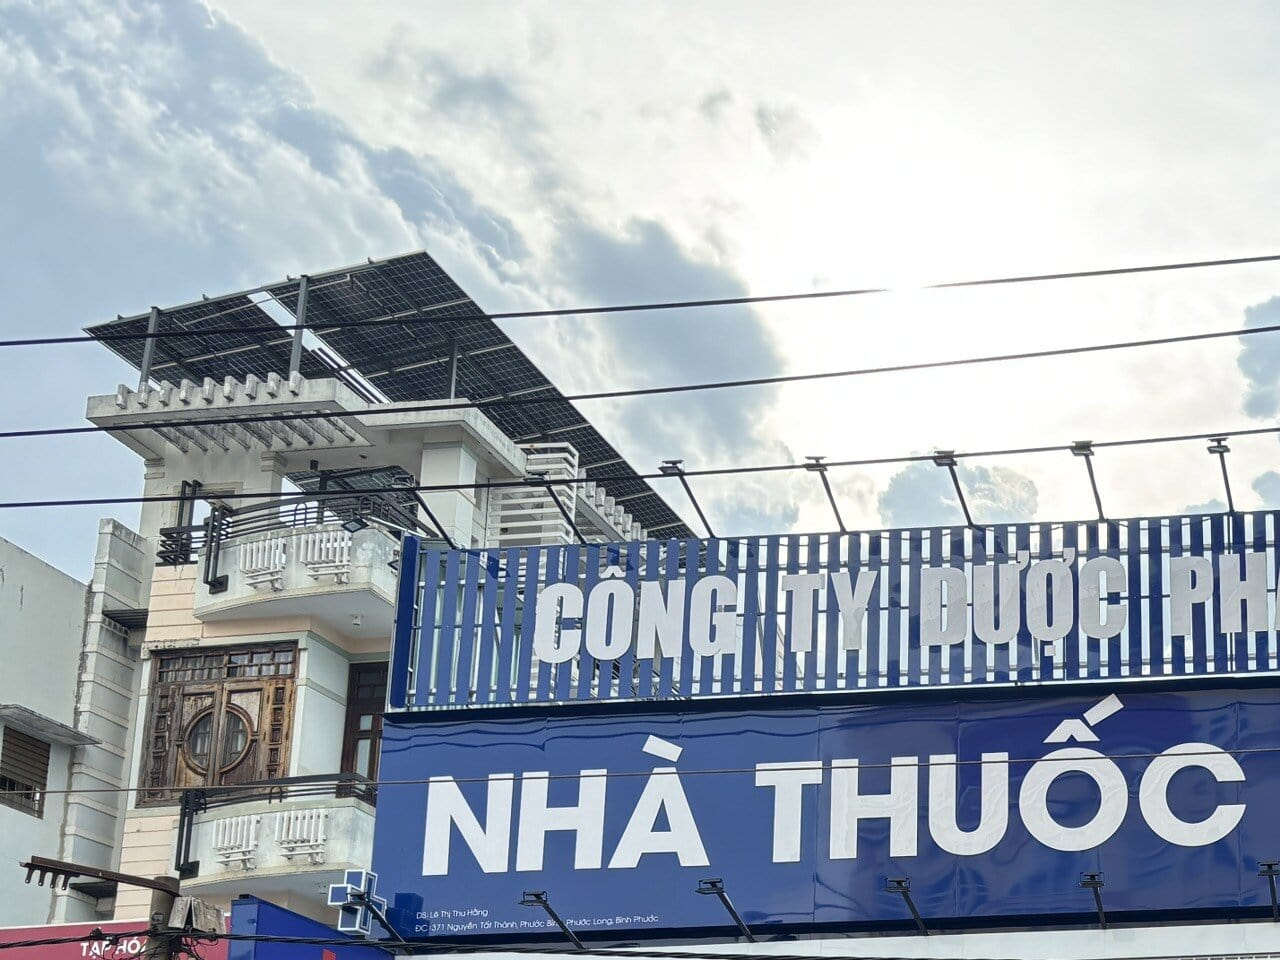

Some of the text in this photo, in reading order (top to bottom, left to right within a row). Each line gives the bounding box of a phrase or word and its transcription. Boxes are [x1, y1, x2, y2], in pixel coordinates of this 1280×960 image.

[534, 566, 738, 664] CÔNG
[780, 569, 878, 653] TY
[919, 546, 1128, 656] DƯỢC
[421, 735, 711, 878] NHÀ
[754, 693, 1248, 865] THUỐC
